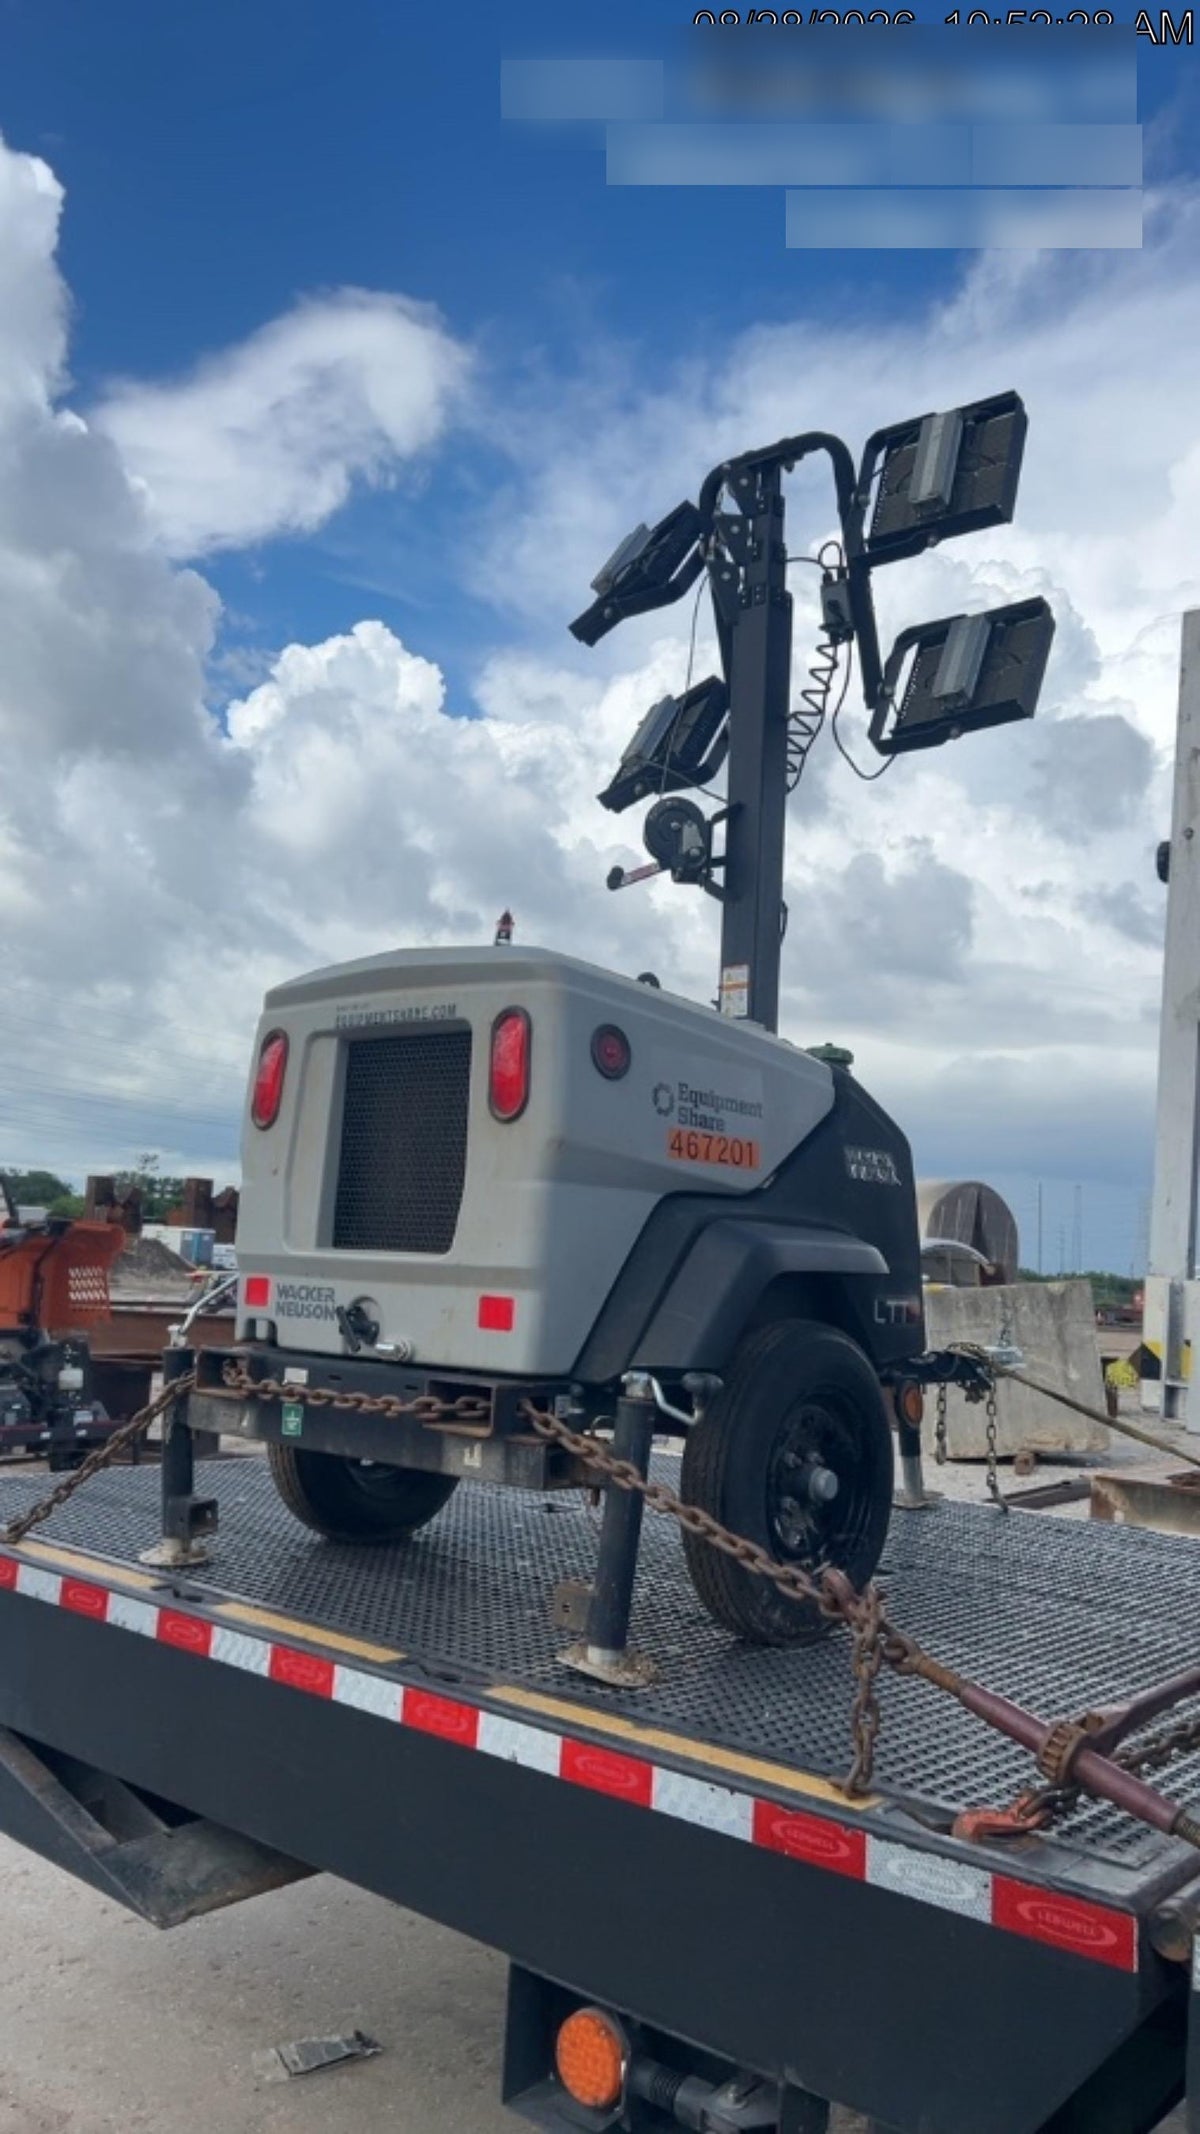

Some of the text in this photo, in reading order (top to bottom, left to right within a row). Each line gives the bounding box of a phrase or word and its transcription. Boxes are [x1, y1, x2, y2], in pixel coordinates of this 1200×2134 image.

[678, 1082, 762, 1118] Equipment
[678, 1107, 725, 1131] Share
[670, 1130, 754, 1167] 467201
[276, 1284, 336, 1302] WACKER
[275, 1301, 337, 1321] NEUSON
